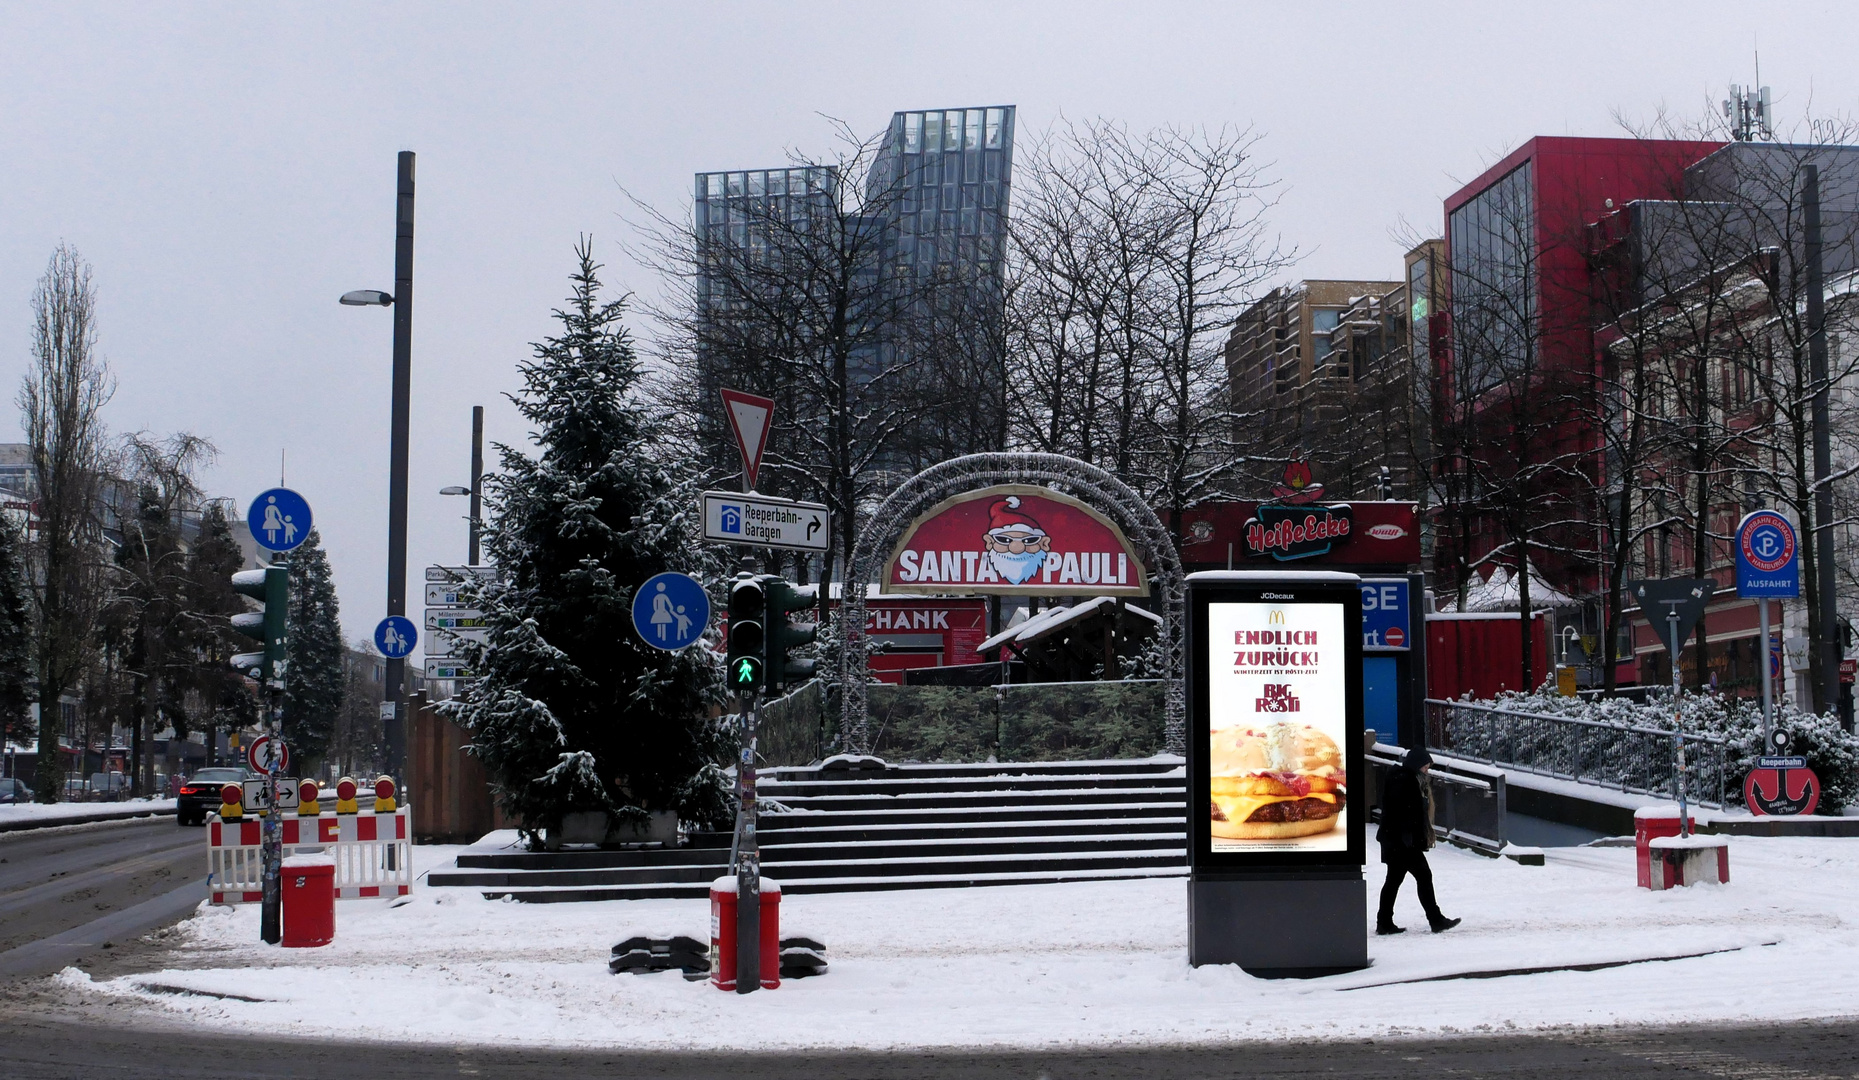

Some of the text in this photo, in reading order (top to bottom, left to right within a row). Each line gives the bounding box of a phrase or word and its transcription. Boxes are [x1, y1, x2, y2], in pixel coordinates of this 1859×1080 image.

[745, 504, 802, 524] Reeperbahn-
[745, 521, 781, 541] Garagen
[1247, 512, 1350, 551] Heiße Ecke
[1743, 517, 1792, 549] REEPERBAHN GARAGEN
[899, 550, 1127, 584] SANTA PAULI
[1752, 559, 1785, 569] HAMBURG
[1746, 580, 1792, 588] AUSFAHRT
[1260, 592, 1295, 600] JCDecaux
[1234, 630, 1318, 645] ENDLICH
[1233, 647, 1319, 666] ZURÜCK!
[1263, 683, 1292, 699] BIG
[1761, 758, 1802, 767] Reeperbahn
